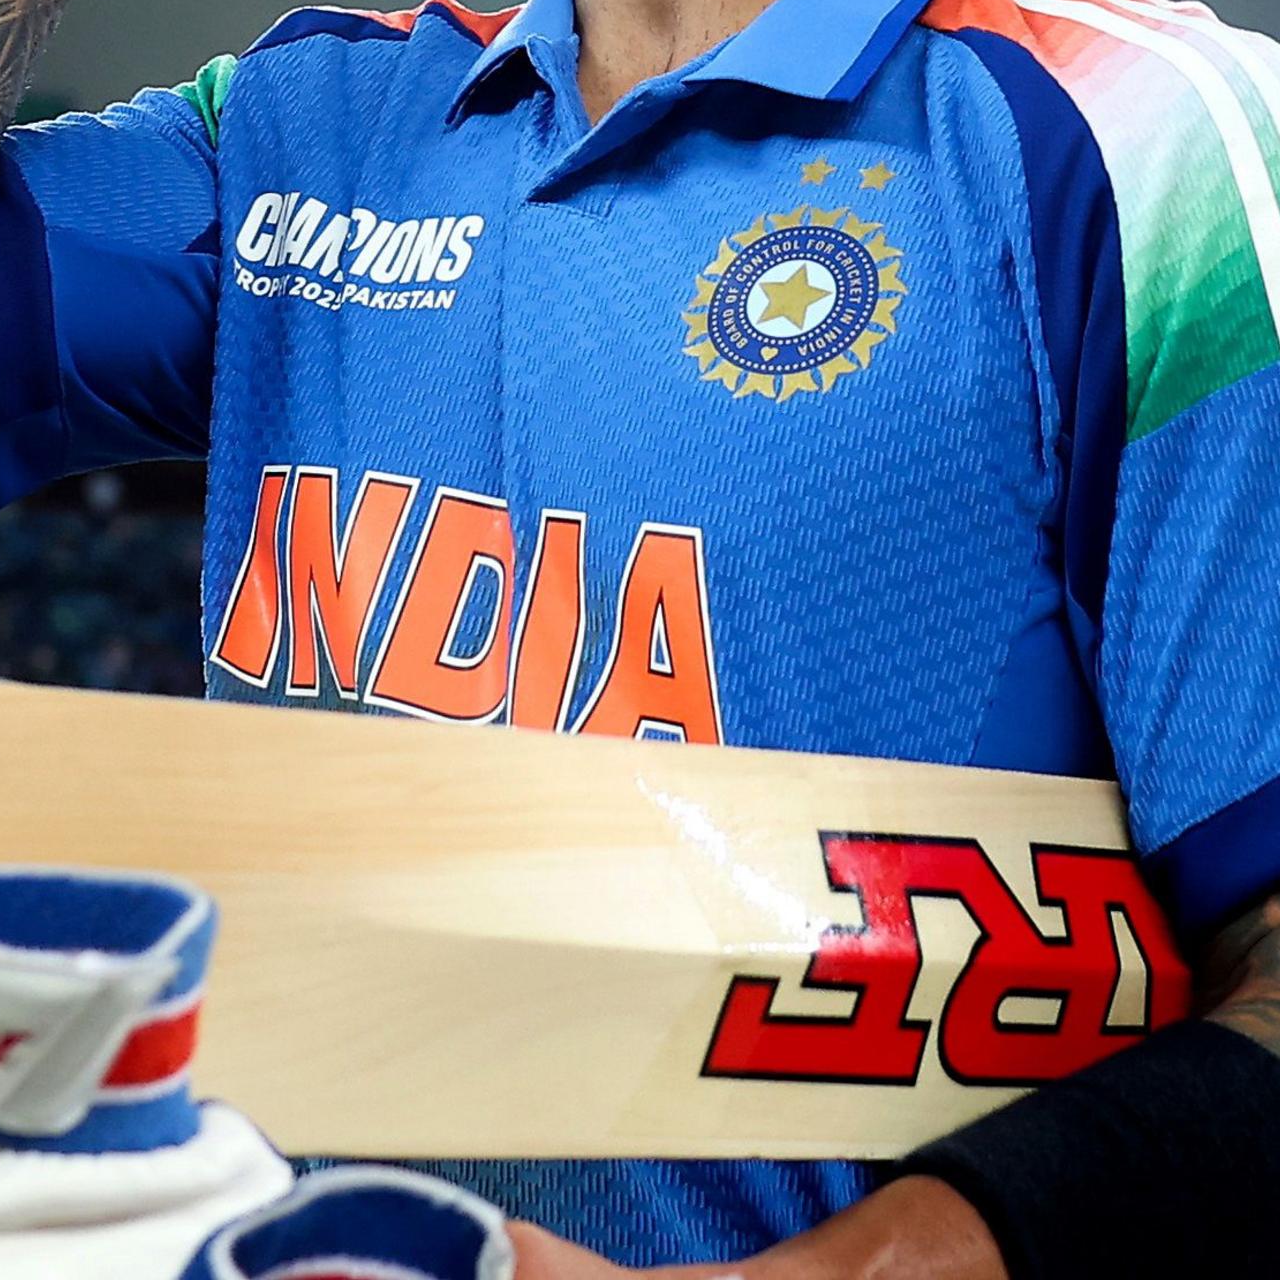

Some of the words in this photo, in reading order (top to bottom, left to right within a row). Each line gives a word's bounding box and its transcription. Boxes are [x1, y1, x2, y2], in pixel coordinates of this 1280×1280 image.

[737, 239, 800, 282] CONTROL
[806, 238, 836, 254] FOR
[835, 250, 863, 304] CRICKET
[342, 283, 456, 311] PAKISTAN
[725, 287, 739, 304] OF
[723, 309, 748, 349] BOARD
[839, 308, 857, 325] IN
[797, 326, 843, 356] INDIA
[209, 465, 724, 745] INDIA
